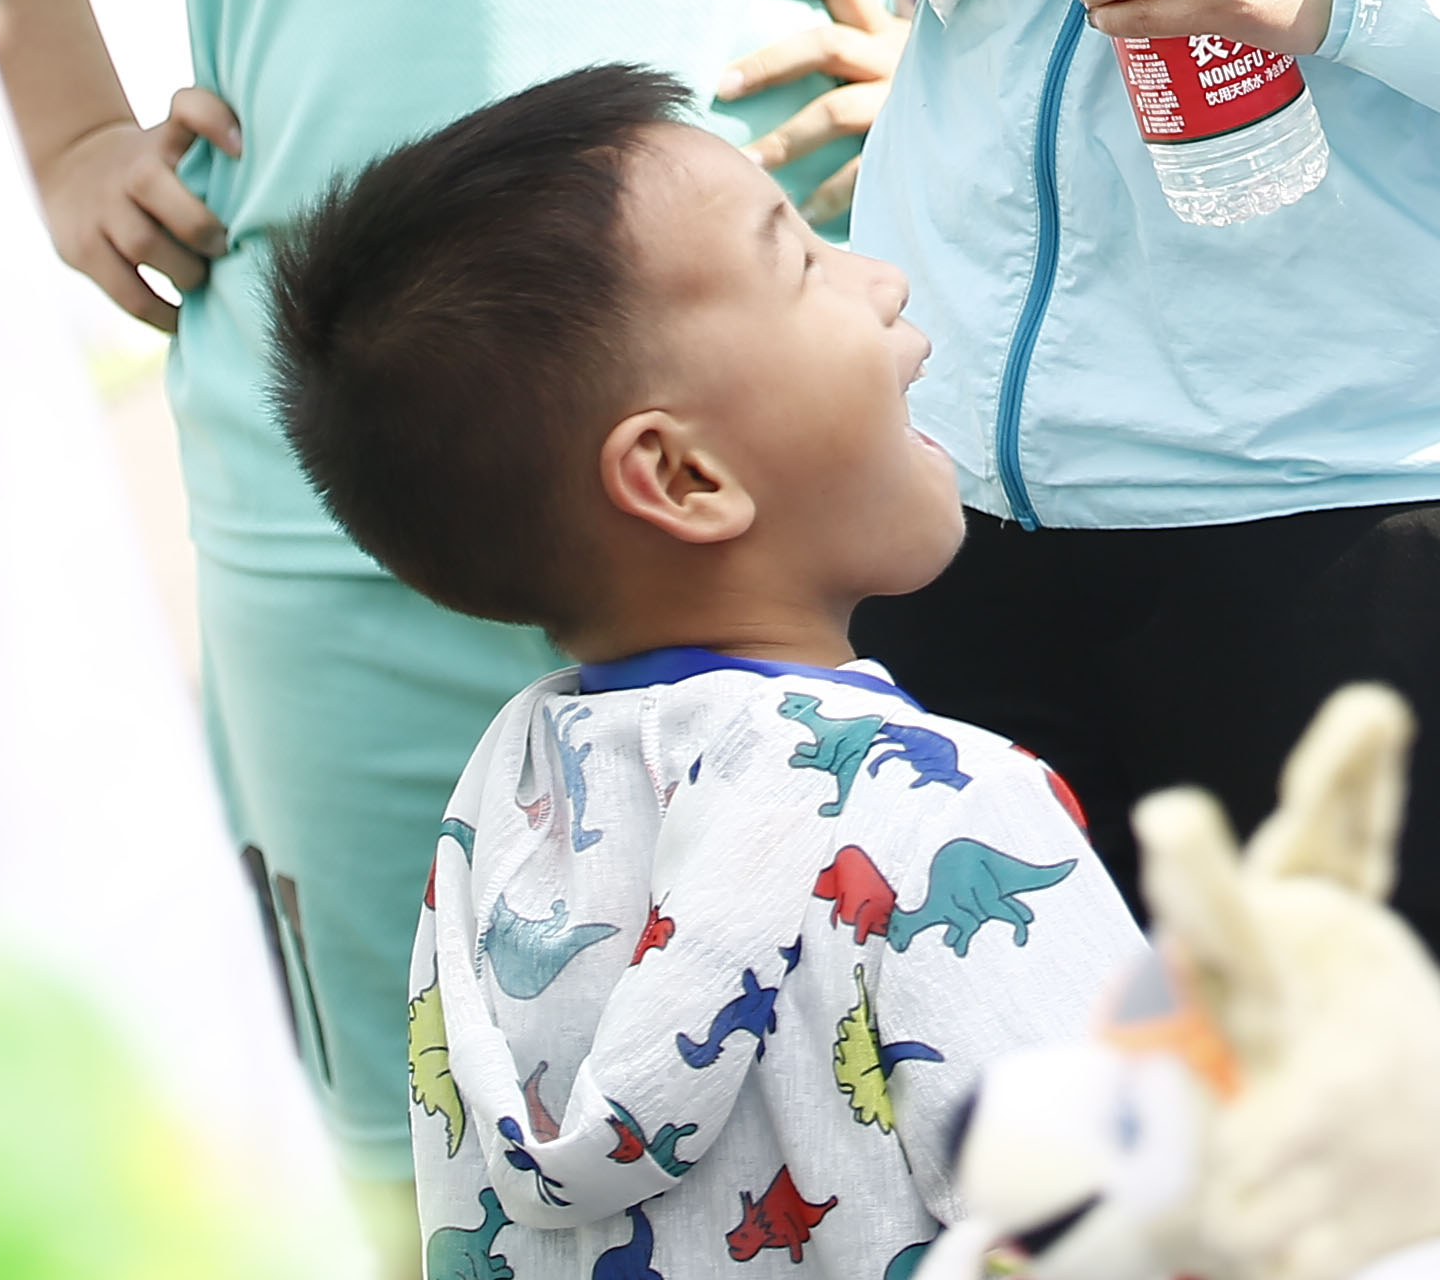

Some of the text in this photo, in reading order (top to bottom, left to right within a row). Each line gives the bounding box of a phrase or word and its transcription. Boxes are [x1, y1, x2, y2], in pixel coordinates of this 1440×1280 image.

[1198, 49, 1264, 89] NONGFU
[1205, 74, 1264, 106] 饮用天然水
